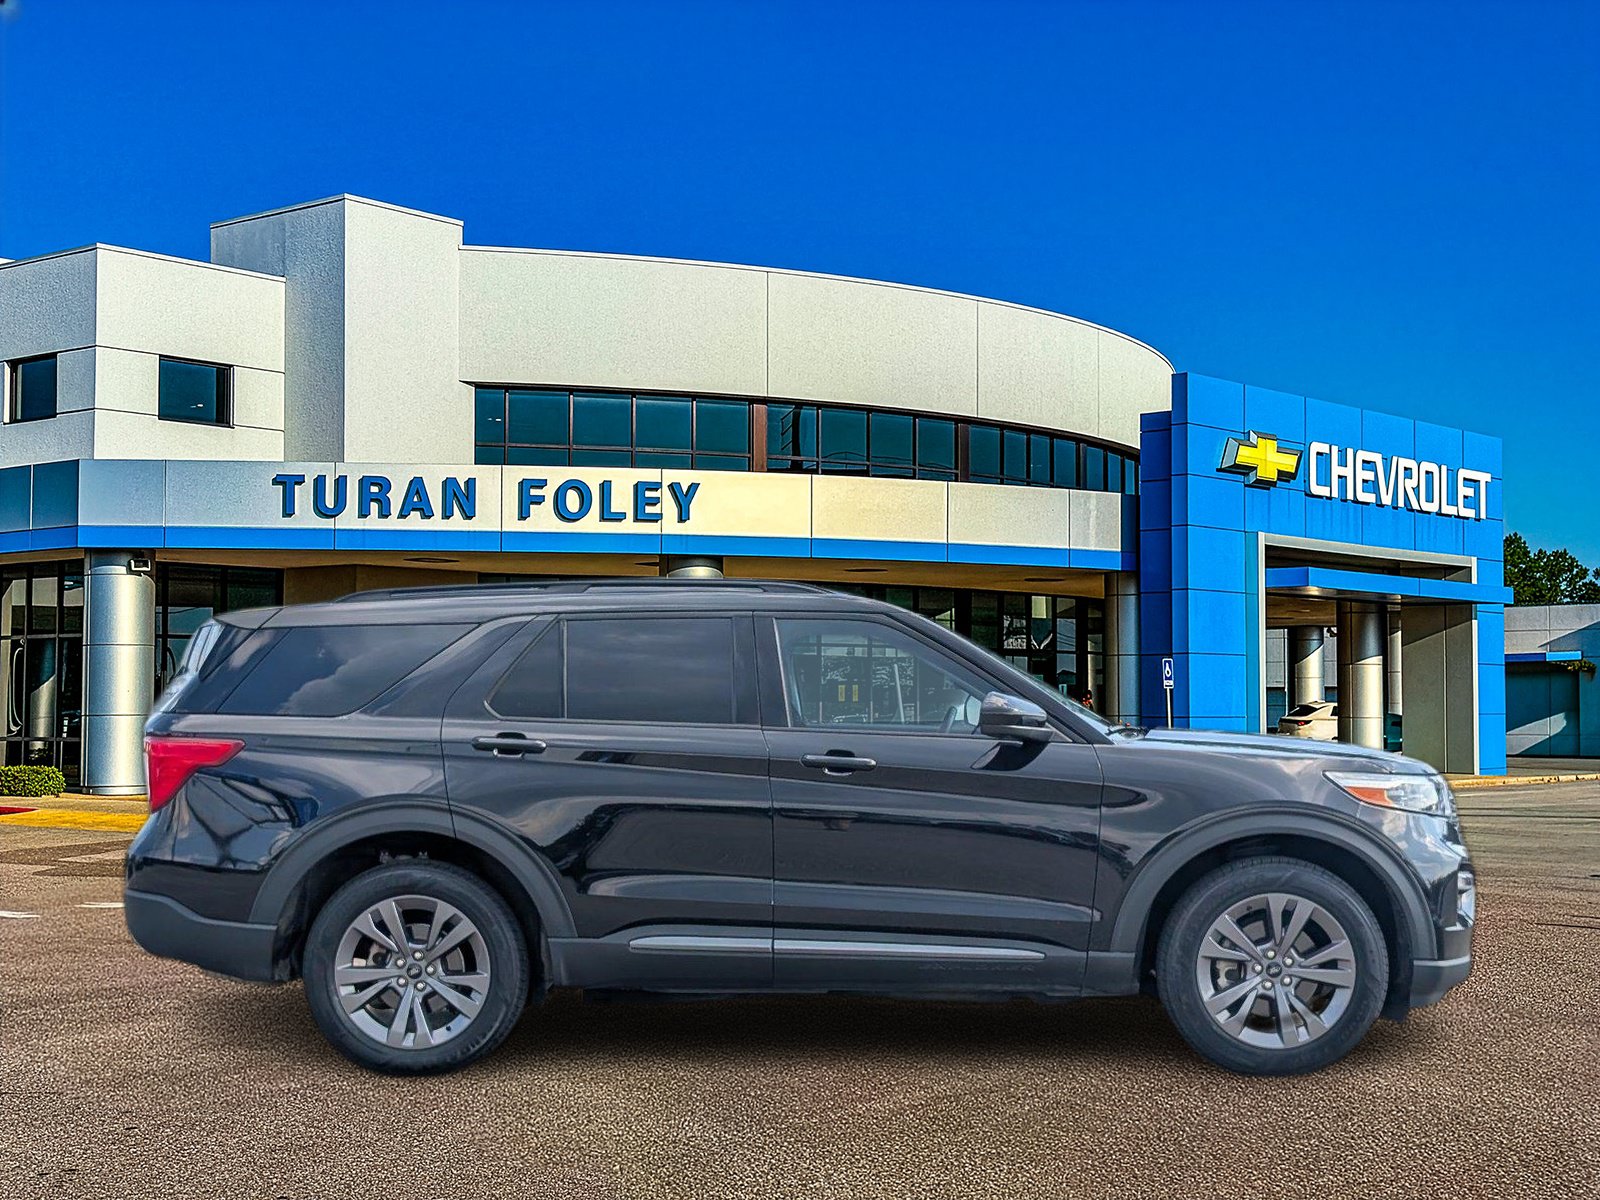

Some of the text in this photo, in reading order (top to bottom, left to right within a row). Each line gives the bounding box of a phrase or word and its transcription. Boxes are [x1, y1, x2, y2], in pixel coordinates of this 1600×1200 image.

[272, 473, 700, 523] TURAN FOLEY
[1308, 441, 1492, 520] CHEVROLET
